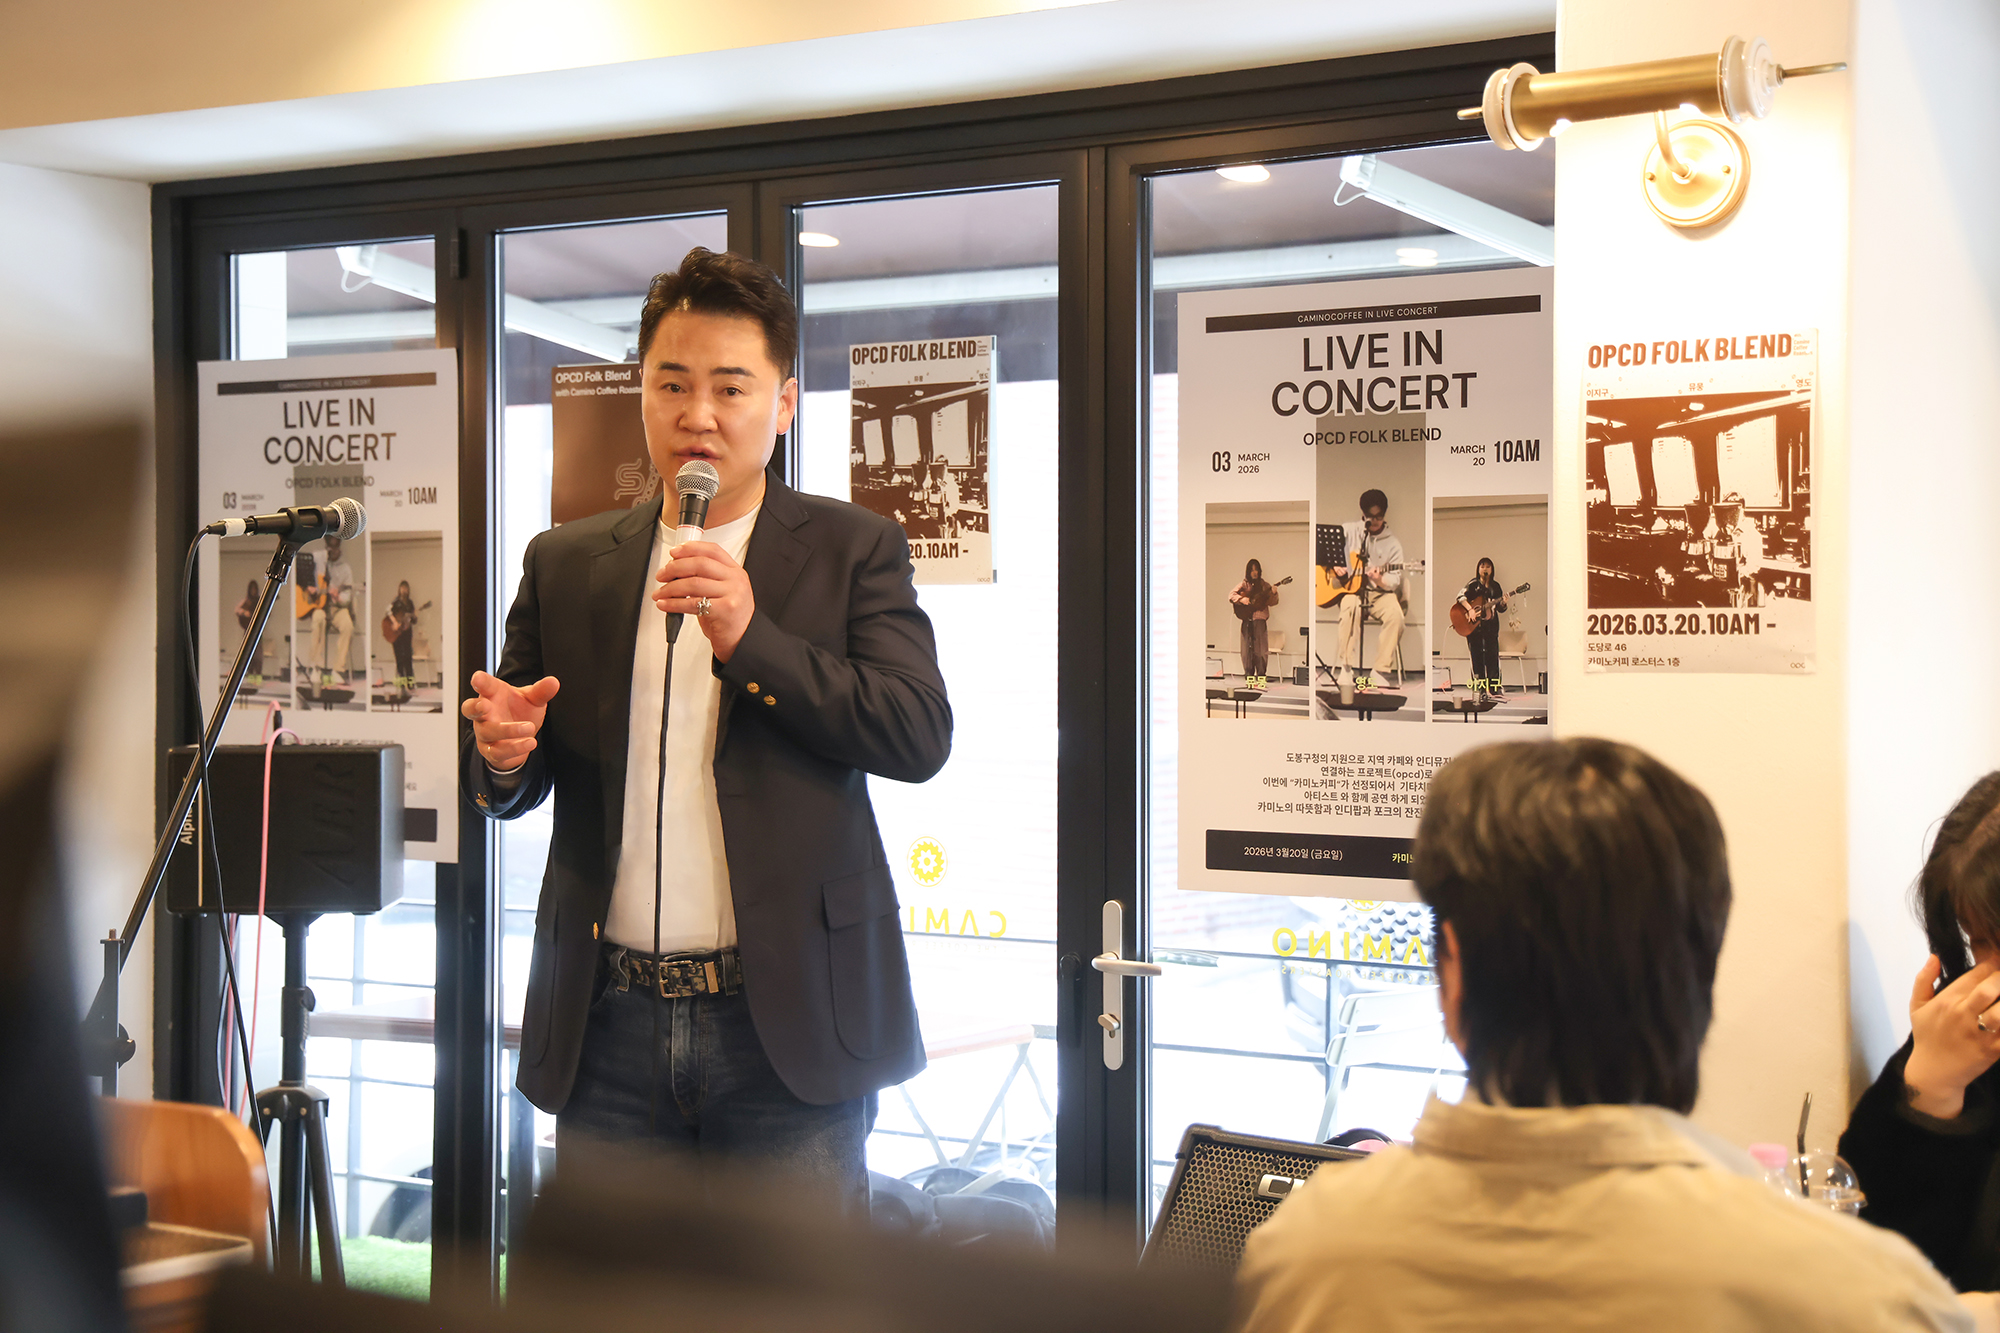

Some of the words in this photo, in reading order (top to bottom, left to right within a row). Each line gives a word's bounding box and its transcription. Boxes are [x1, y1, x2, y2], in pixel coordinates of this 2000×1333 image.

[1297, 311, 1363, 323] CAMINOCOFFEE
[1365, 310, 1374, 319] IN
[1376, 309, 1394, 318] LIVE
[1396, 306, 1438, 317] CONCERT
[852, 346, 888, 365] OPCD
[891, 343, 927, 363] FOLK
[930, 340, 977, 360] BLEND
[1303, 332, 1389, 372] LIVE
[1403, 329, 1443, 367] IN
[1587, 342, 1647, 369] OPCD
[1651, 338, 1710, 365] FOLK
[1714, 333, 1792, 361] BLEND
[555, 372, 583, 384] OPCD
[584, 371, 603, 382] Folk
[604, 370, 631, 381] Blend
[1271, 372, 1477, 417] CONCERT
[283, 399, 340, 429] LIVE
[349, 397, 375, 426] IN
[1303, 430, 1346, 446] OPCD
[1350, 429, 1388, 444] FOLK
[1392, 427, 1442, 443] BLEND
[263, 432, 396, 465] CONCERT
[1450, 444, 1486, 455] MARCH
[1494, 439, 1541, 463] 10AM
[1211, 450, 1231, 472] 03
[1237, 452, 1271, 462] MARCH
[1472, 457, 1486, 467] 20
[1237, 464, 1260, 474] 2026
[285, 477, 313, 489] OPCD
[314, 476, 340, 488] FOLK
[342, 475, 375, 488] BLEND
[222, 491, 237, 510] 03
[408, 486, 437, 505] 10AM
[908, 542, 959, 559] 20.10AM
[1587, 613, 1760, 636] 2026.03.20.10AM
[1588, 642, 1612, 652] 도당로
[1614, 643, 1627, 652] 46
[1588, 657, 1630, 666] 카미노커피
[1631, 657, 1665, 668] 로스터스
[1667, 657, 1680, 667] 1층
[1355, 676, 1378, 690] 영도
[1286, 752, 1328, 764] 도봉구청의
[1330, 754, 1365, 764] 지원으로
[1368, 755, 1384, 765] 지역
[1387, 756, 1414, 766] 카페와
[1416, 756, 1455, 768] 인디뮤지
[1320, 766, 1355, 777] 연결하는
[1357, 768, 1432, 780] 프로젝트(opcd)로
[1262, 777, 1288, 788] 이번에
[1352, 780, 1395, 791] 선정되어서
[1304, 790, 1338, 802] 아티스트
[1340, 792, 1349, 802] 와
[1351, 792, 1368, 803] 함께
[1371, 793, 1388, 804] 공연
[1390, 794, 1408, 804] 하게
[1258, 802, 1293, 813] 카미노의
[1296, 803, 1332, 814] 따뜻함과
[1334, 804, 1372, 816] 인디팝과
[1374, 806, 1402, 818] 포크의
[180, 807, 196, 845] Alp
[1244, 846, 1274, 857] 2026년
[1276, 848, 1309, 859] 3월20일
[1310, 849, 1343, 861] (금요일)
